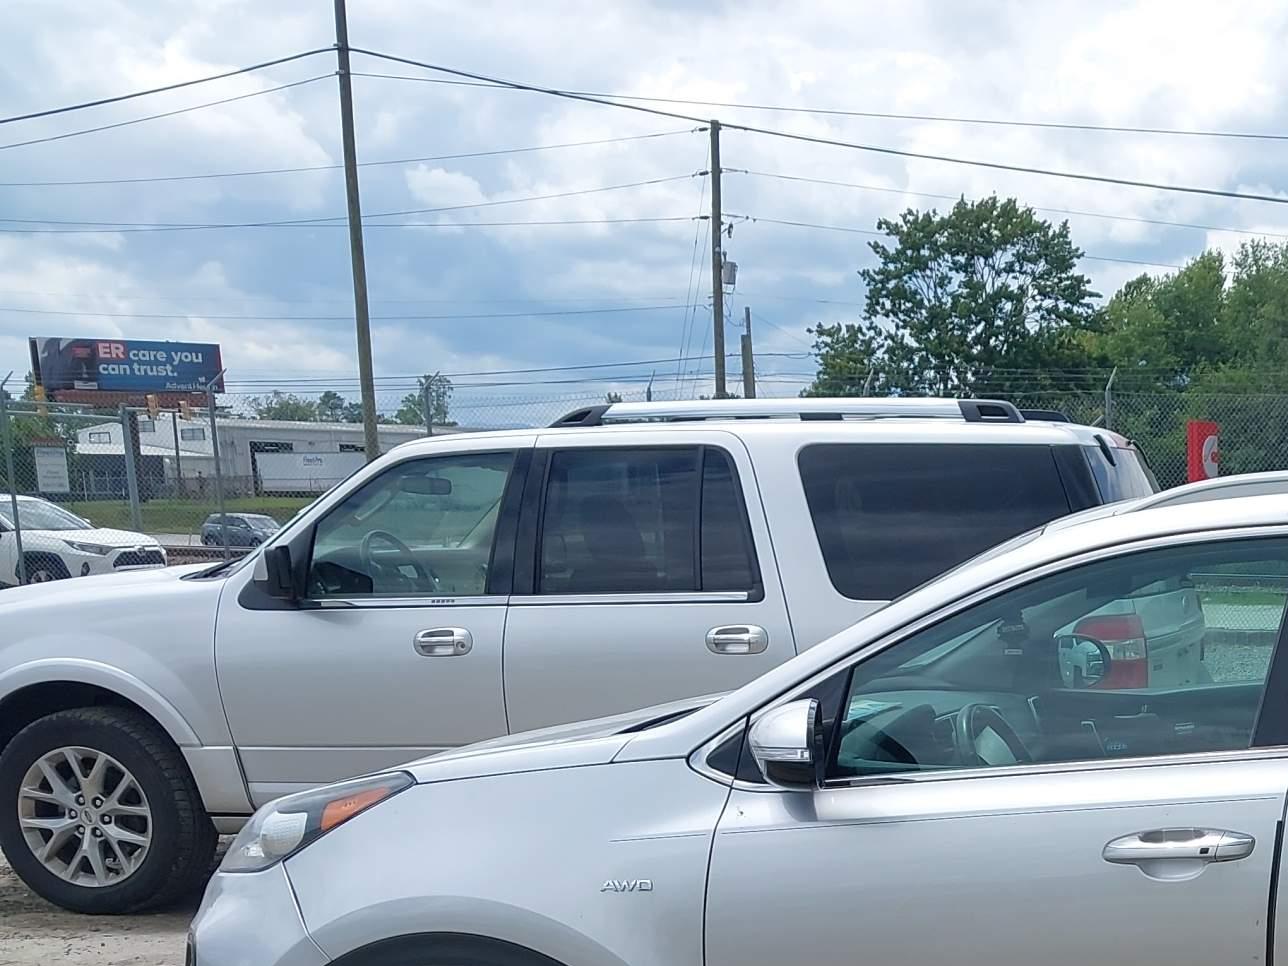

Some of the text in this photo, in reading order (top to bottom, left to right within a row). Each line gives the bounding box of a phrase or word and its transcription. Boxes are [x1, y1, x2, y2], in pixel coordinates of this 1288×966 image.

[98, 342, 203, 365] ER care you
[98, 361, 178, 377] can trust.
[600, 879, 654, 892] AWD
